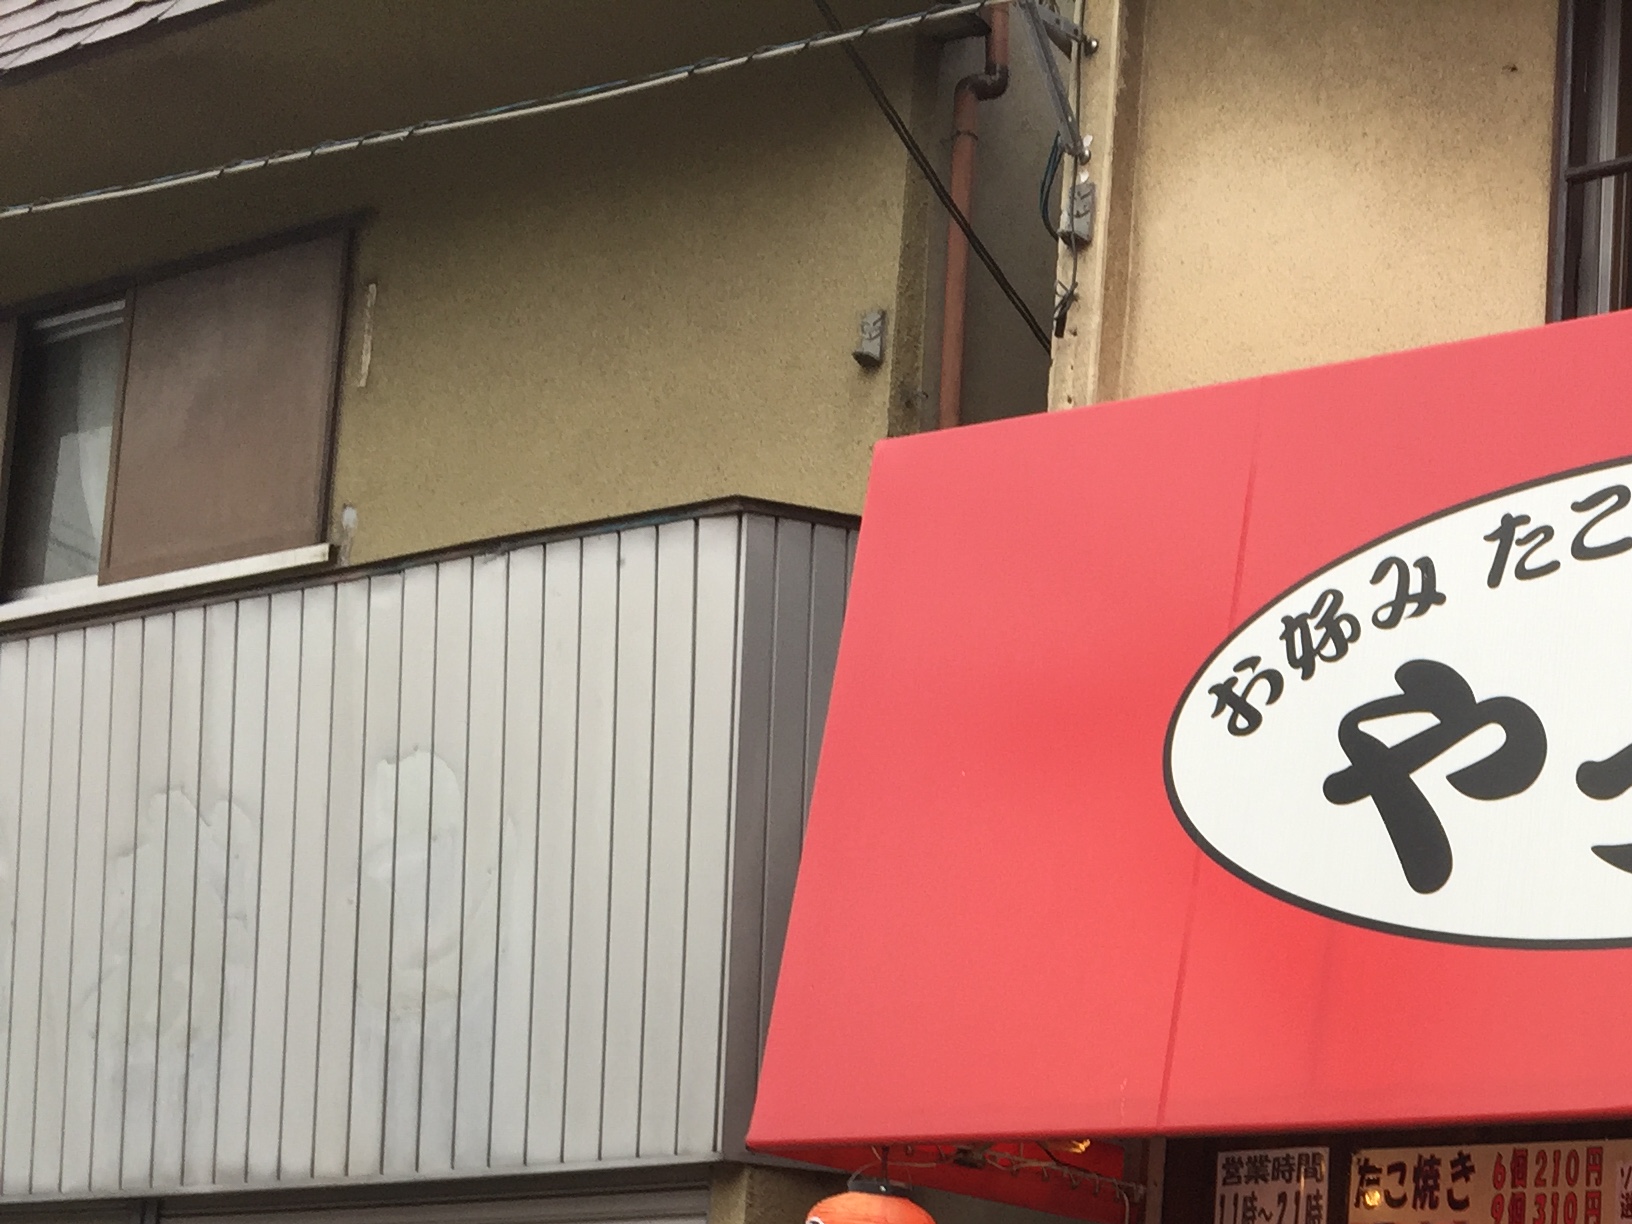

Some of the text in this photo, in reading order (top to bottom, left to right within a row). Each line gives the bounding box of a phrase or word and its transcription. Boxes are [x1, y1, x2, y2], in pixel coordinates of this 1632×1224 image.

[1209, 557, 1446, 736] お好み
[1221, 1152, 1326, 1187] 営業時間
[1353, 1150, 1476, 1212] たこ焼き
